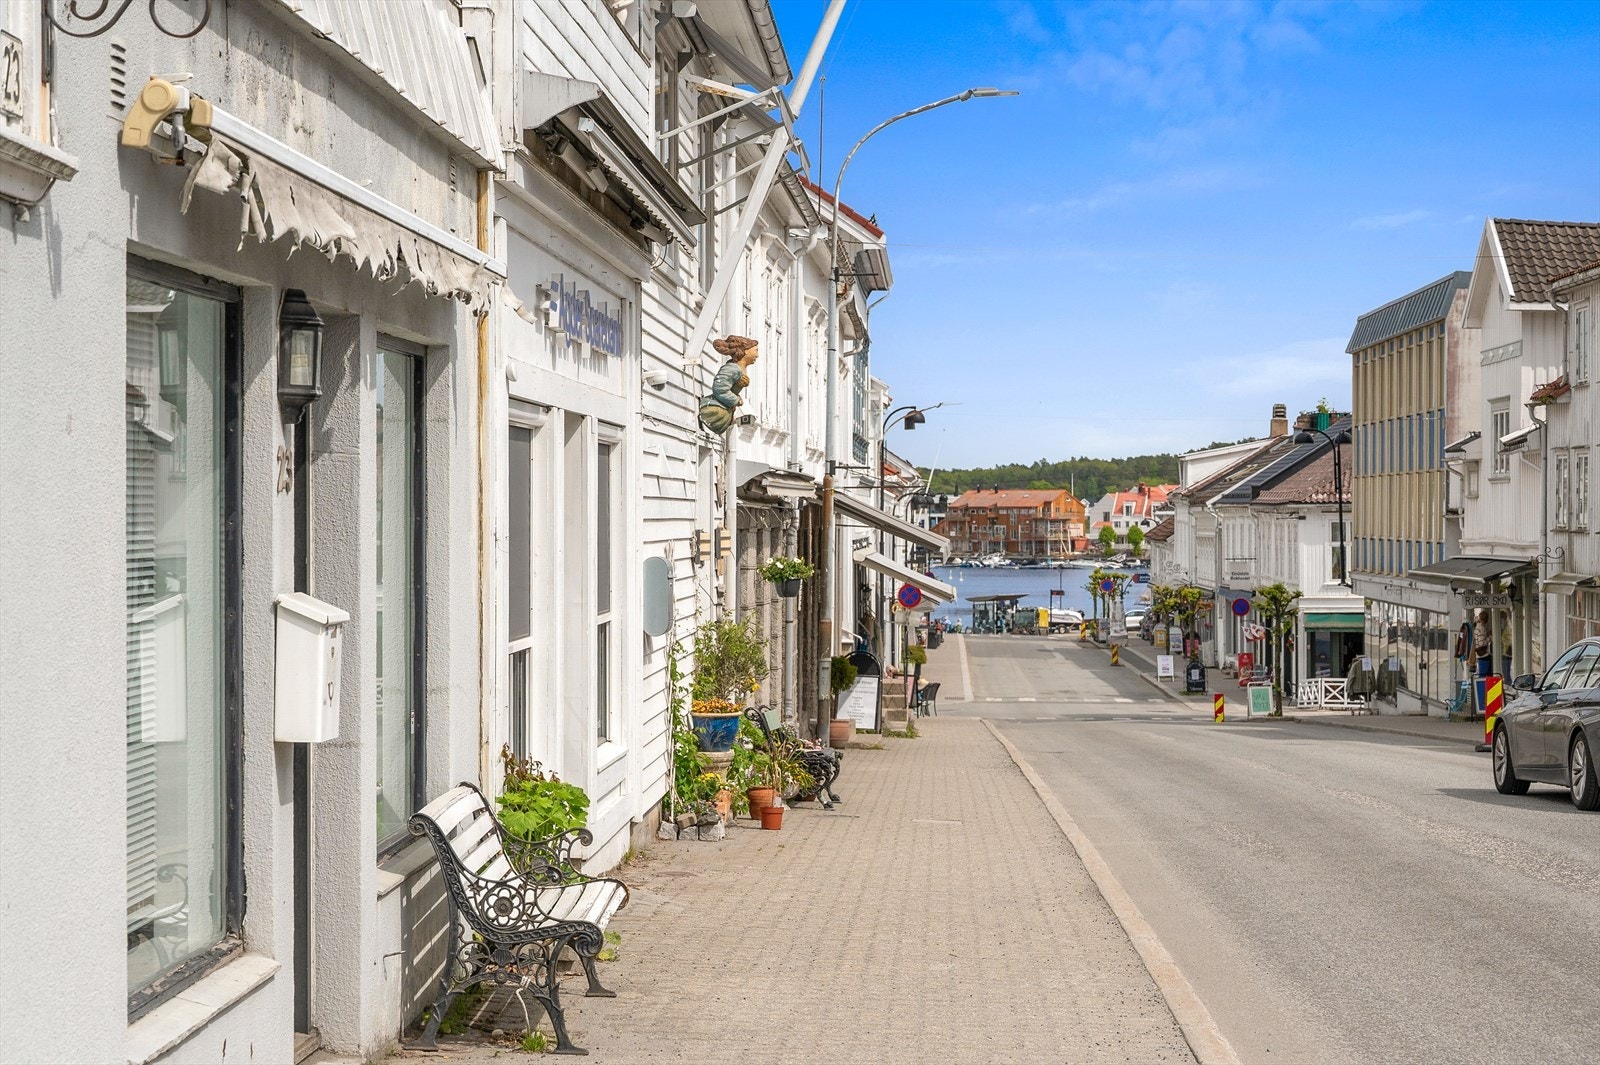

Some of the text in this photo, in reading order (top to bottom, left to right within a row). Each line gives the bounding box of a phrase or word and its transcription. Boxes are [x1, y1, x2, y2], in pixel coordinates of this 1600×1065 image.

[4, 46, 20, 103] 23
[1464, 595, 1507, 607] RISØR SKO
